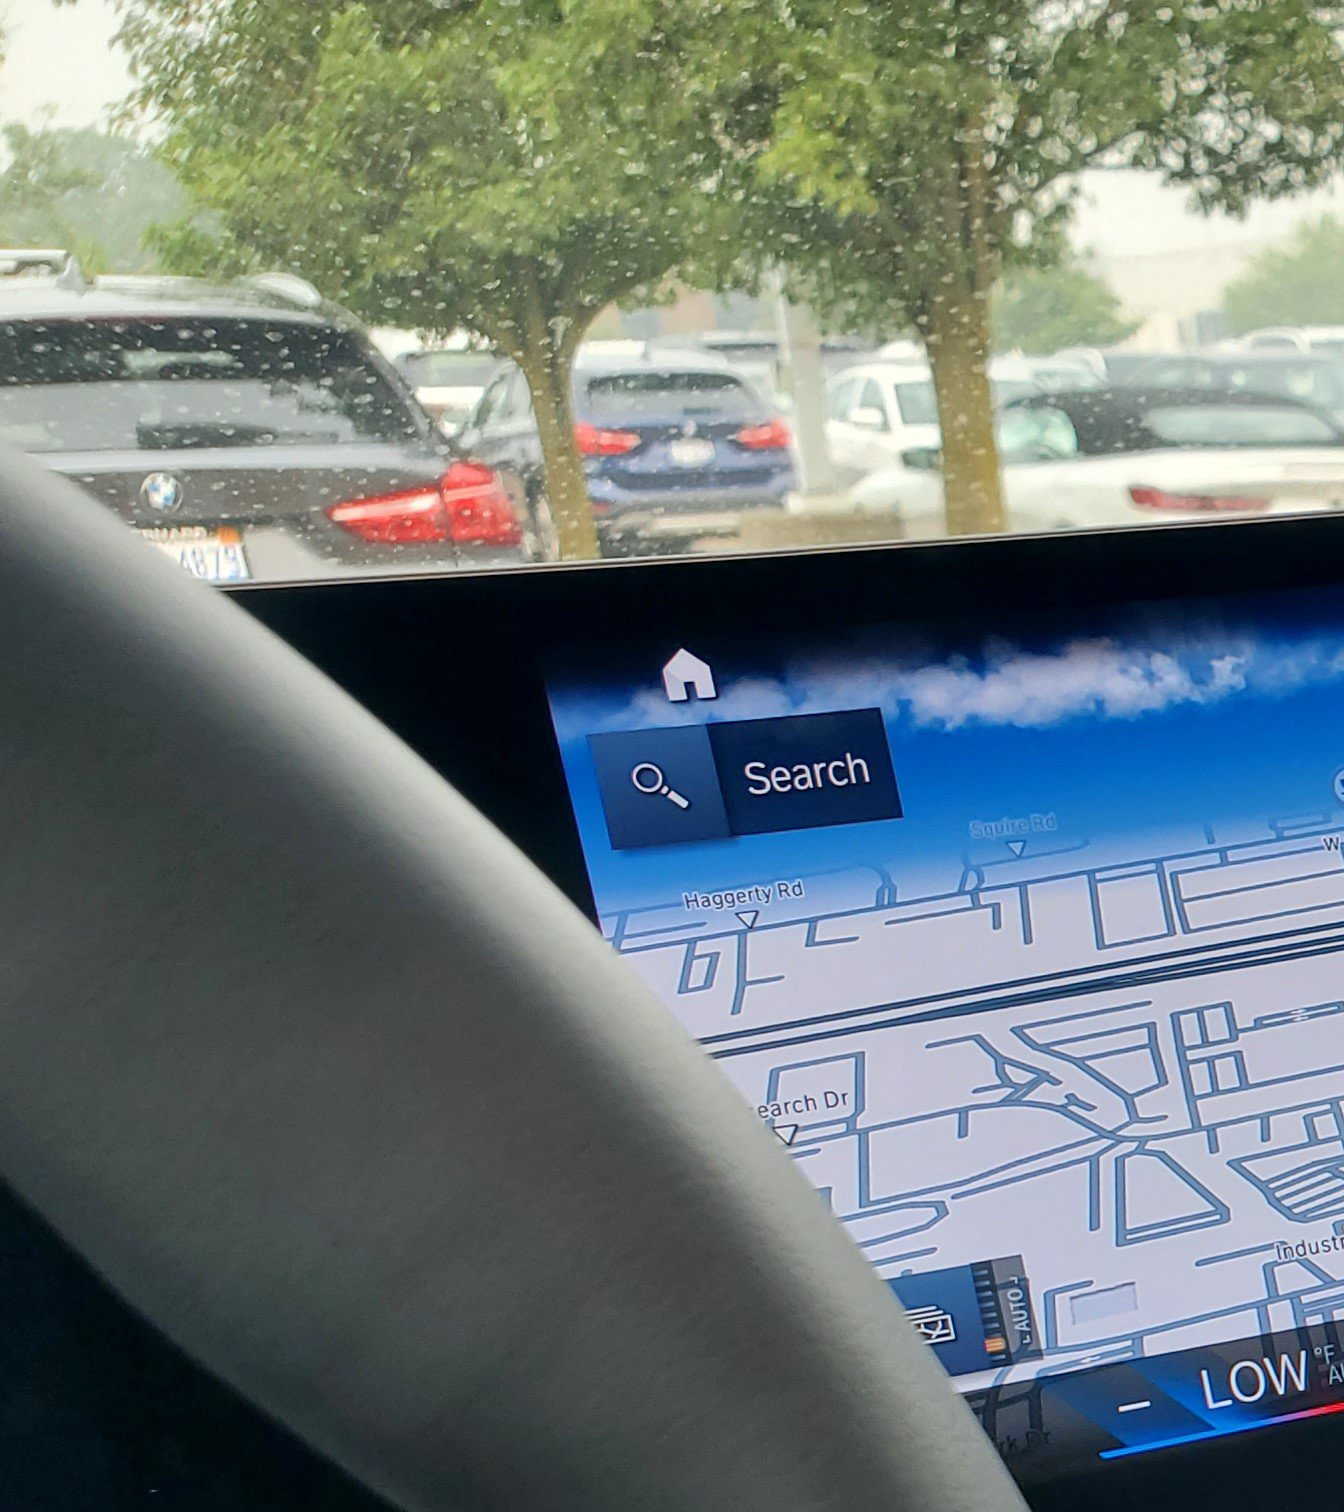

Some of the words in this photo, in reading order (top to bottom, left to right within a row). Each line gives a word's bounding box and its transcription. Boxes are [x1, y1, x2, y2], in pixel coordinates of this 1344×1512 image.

[743, 752, 871, 795] Search
[1031, 813, 1056, 831] Rd
[1323, 836, 1340, 852] W
[684, 886, 772, 910] Haggerty
[777, 880, 804, 899] Rd
[824, 1090, 849, 1109] Dr
[1007, 1288, 1032, 1331] AUTO
[1200, 1349, 1308, 1410] LOW
